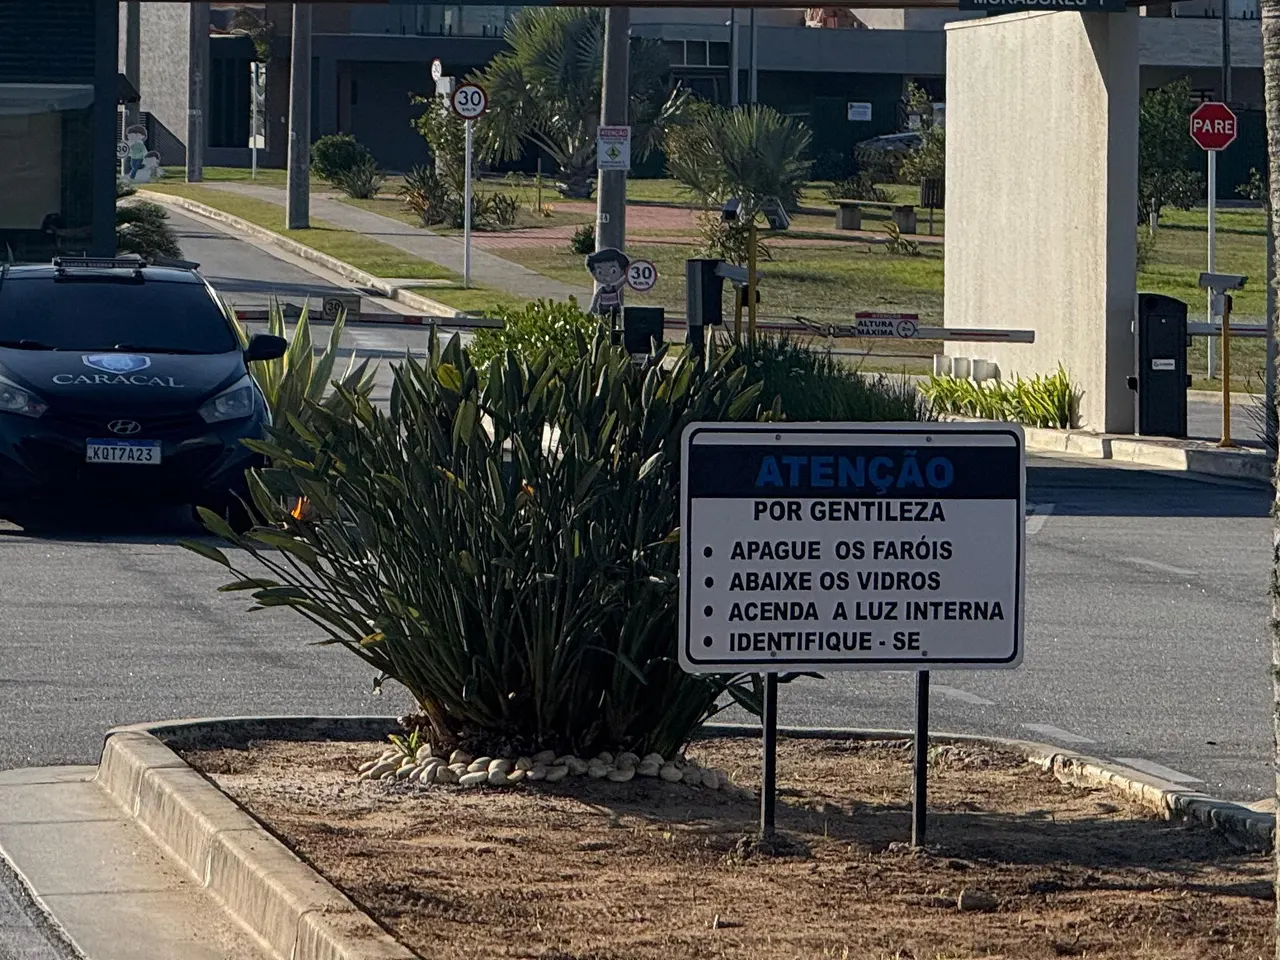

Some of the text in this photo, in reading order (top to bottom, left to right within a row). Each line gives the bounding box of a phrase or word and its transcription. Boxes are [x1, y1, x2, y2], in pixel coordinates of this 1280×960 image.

[458, 90, 482, 107] 30
[1193, 119, 1234, 134] PARE
[630, 266, 653, 280] 30
[327, 302, 340, 311] 30
[857, 320, 894, 328] ALTURA
[857, 328, 894, 337] MÁXIMA
[52, 373, 185, 388] CARACAL
[93, 446, 153, 462] KQT7A23
[754, 449, 955, 495] ATENÇÃO
[753, 501, 946, 522] POR GENTILEZA
[730, 535, 953, 561] APAGUE OS FARÓIS
[729, 571, 941, 591] ABAIXE OS VIDROS
[728, 601, 1005, 621] ACENDA A LUZ INTERNA
[729, 632, 872, 653] IDENTIFIQUE
[892, 631, 921, 651] SE
